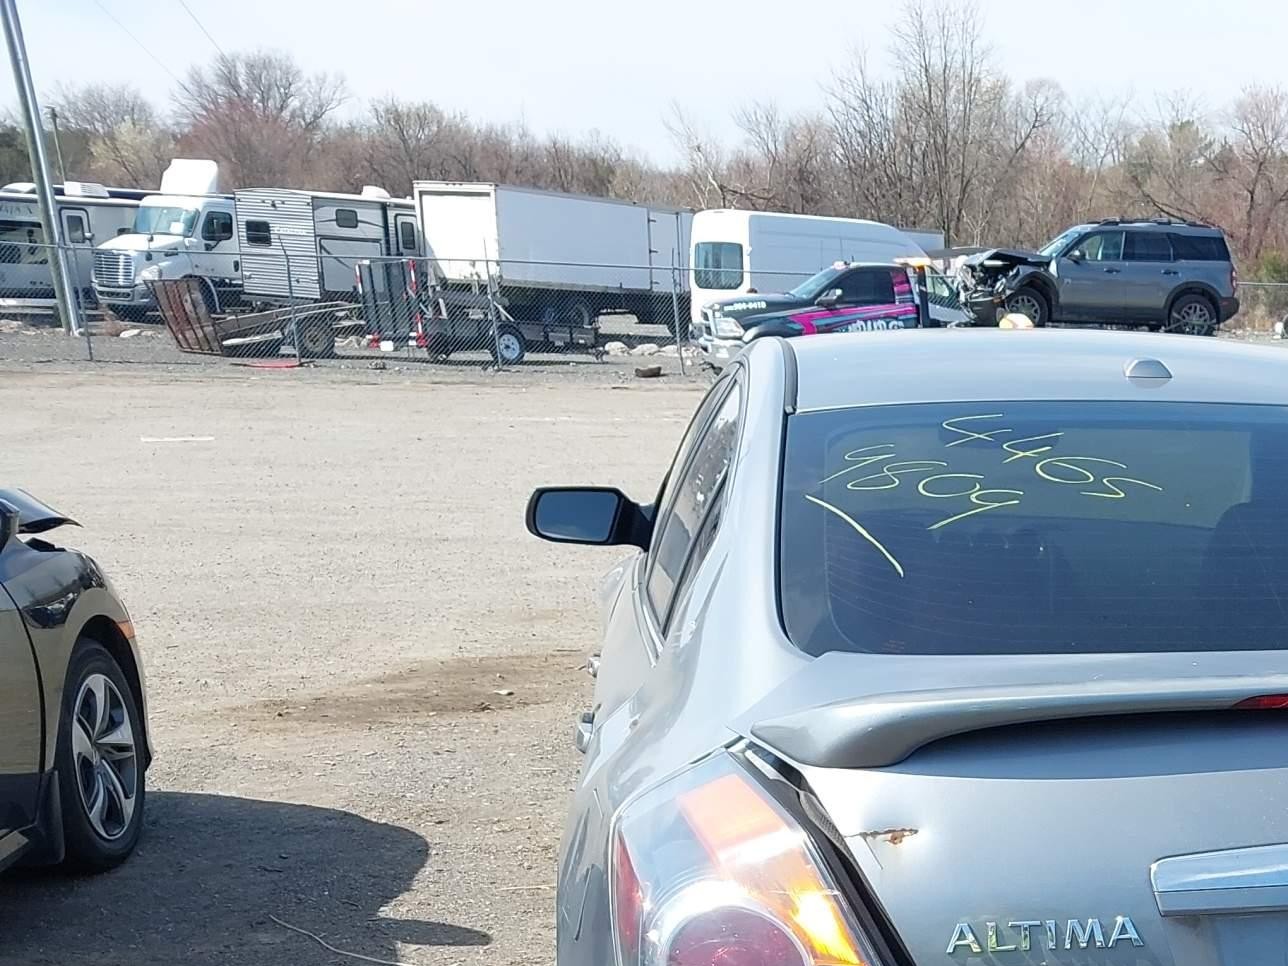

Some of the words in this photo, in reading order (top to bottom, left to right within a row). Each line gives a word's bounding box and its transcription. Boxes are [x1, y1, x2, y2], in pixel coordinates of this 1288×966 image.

[818, 443, 1025, 530] 9809
[941, 413, 1164, 498] 4465
[945, 916, 1145, 954] ALTIMA
